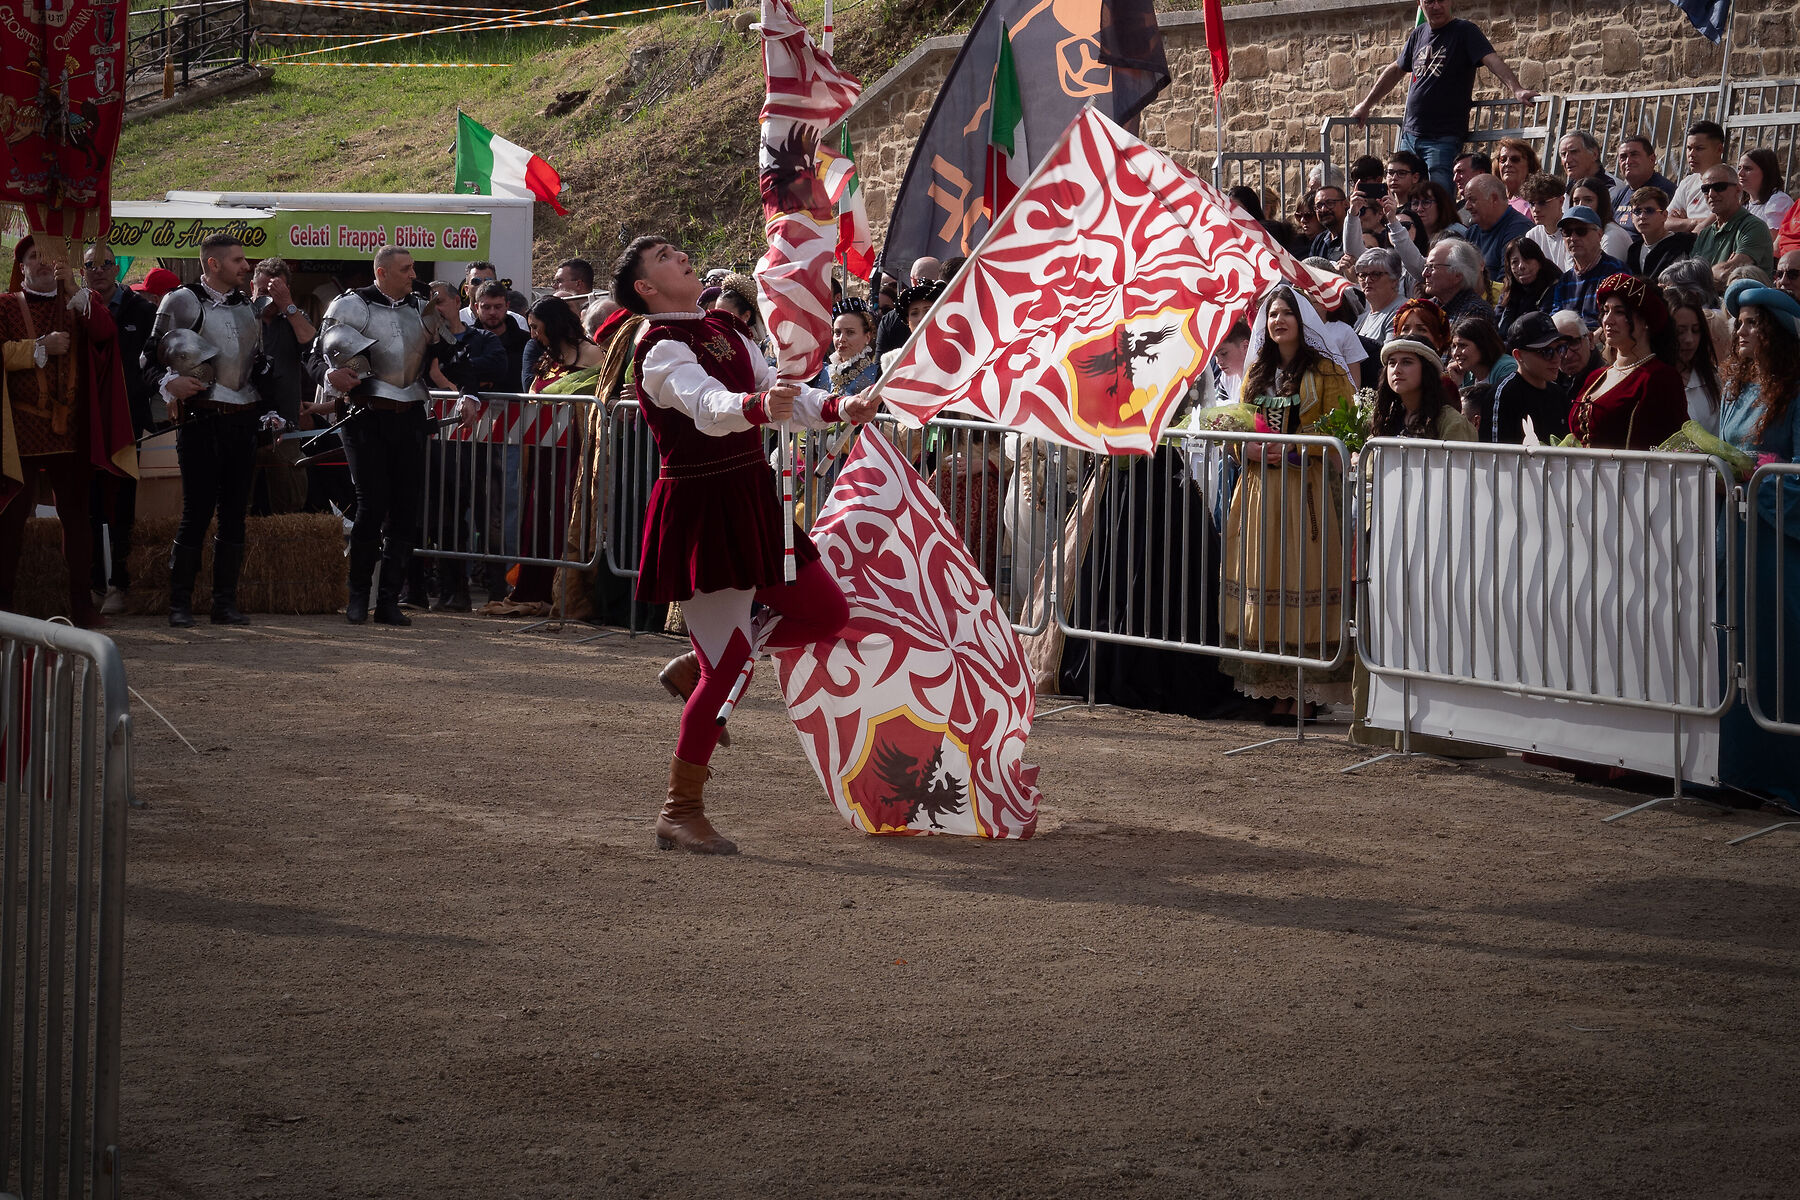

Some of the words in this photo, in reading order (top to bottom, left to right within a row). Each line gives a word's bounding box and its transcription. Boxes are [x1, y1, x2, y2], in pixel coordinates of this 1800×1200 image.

[152, 220, 175, 246] di
[289, 224, 330, 247] Gelati
[337, 225, 386, 252] Frappè
[395, 225, 435, 248] Bibite
[442, 226, 478, 250] Caffè
